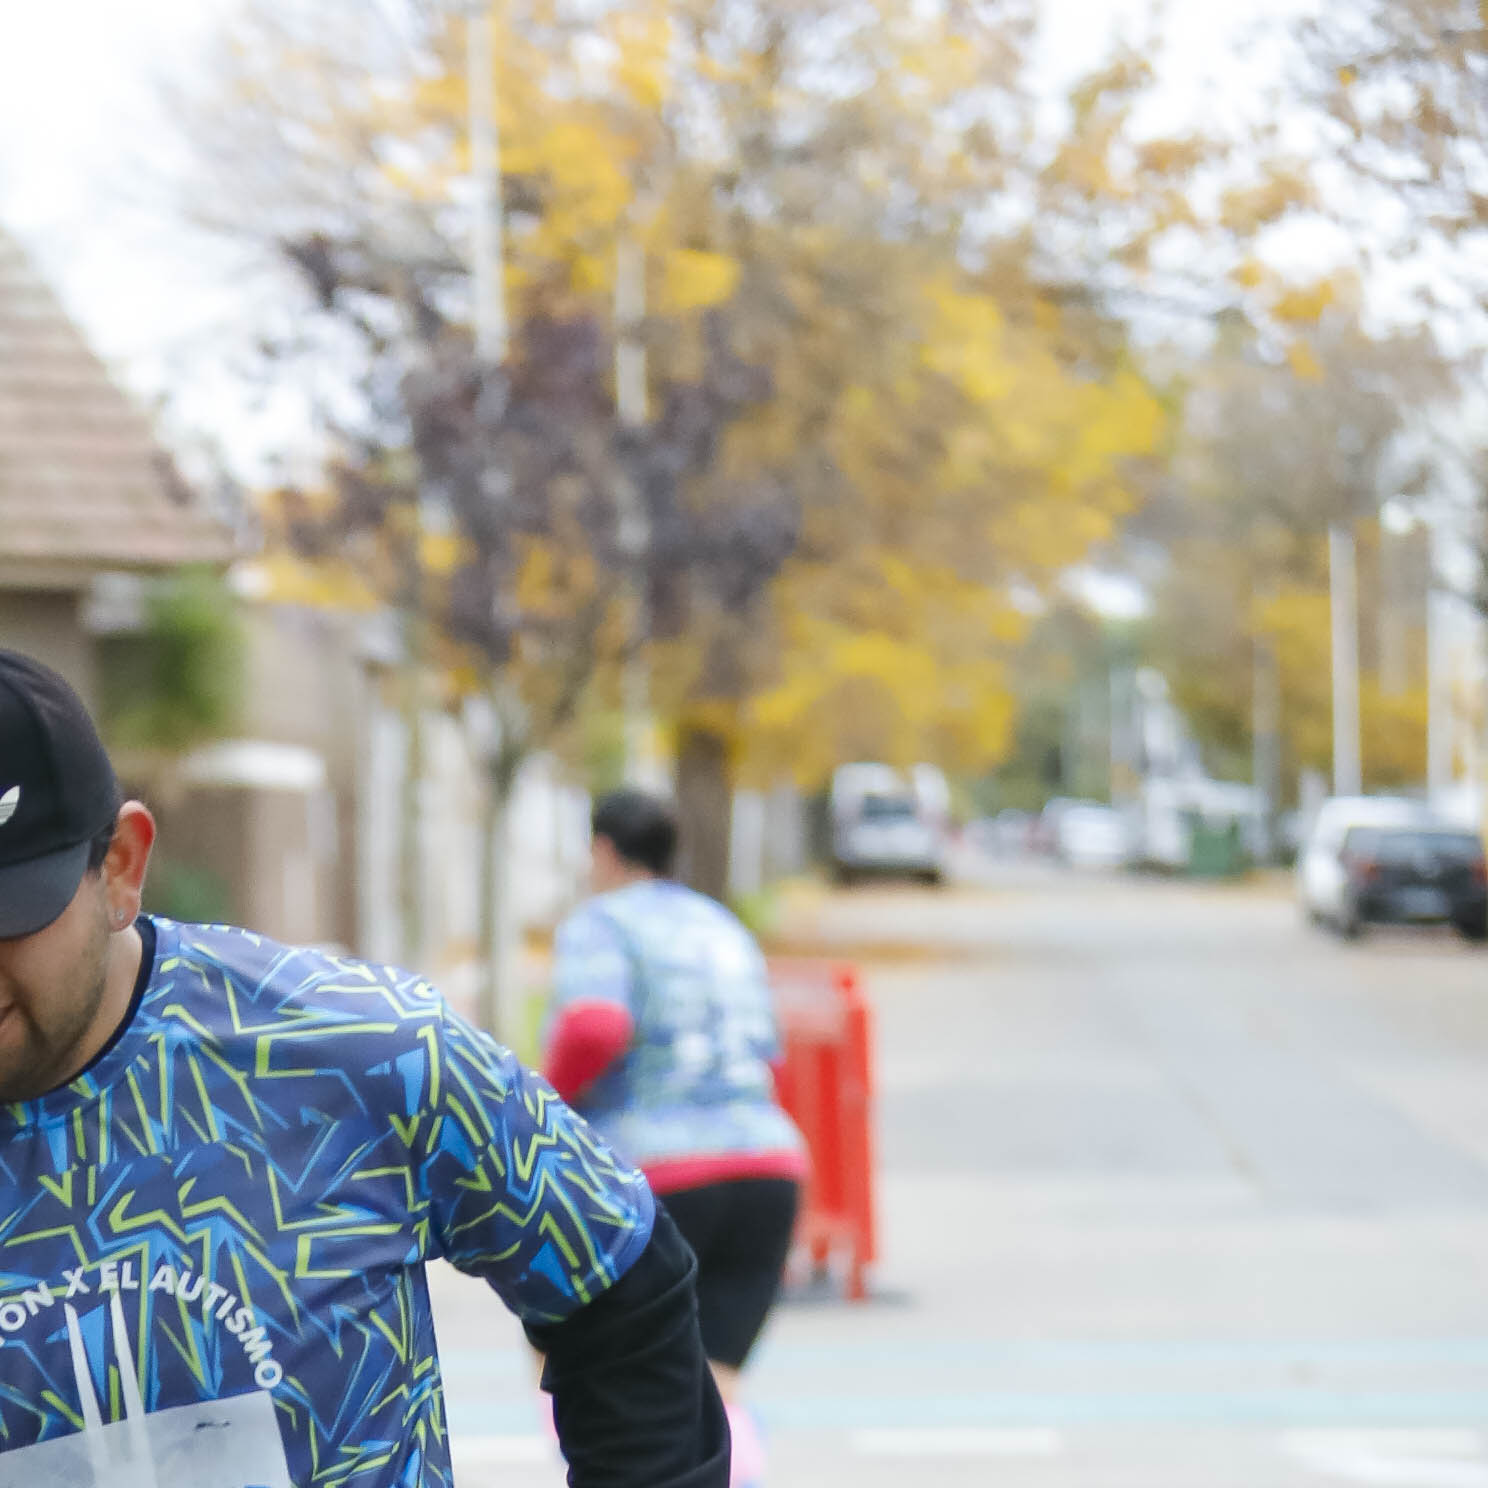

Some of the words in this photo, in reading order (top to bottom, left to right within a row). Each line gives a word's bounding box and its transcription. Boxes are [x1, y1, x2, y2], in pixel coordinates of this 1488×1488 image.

[63, 1266, 90, 1297] X
[99, 1261, 139, 1293] EL
[149, 1264, 283, 1389] AUTISMO
